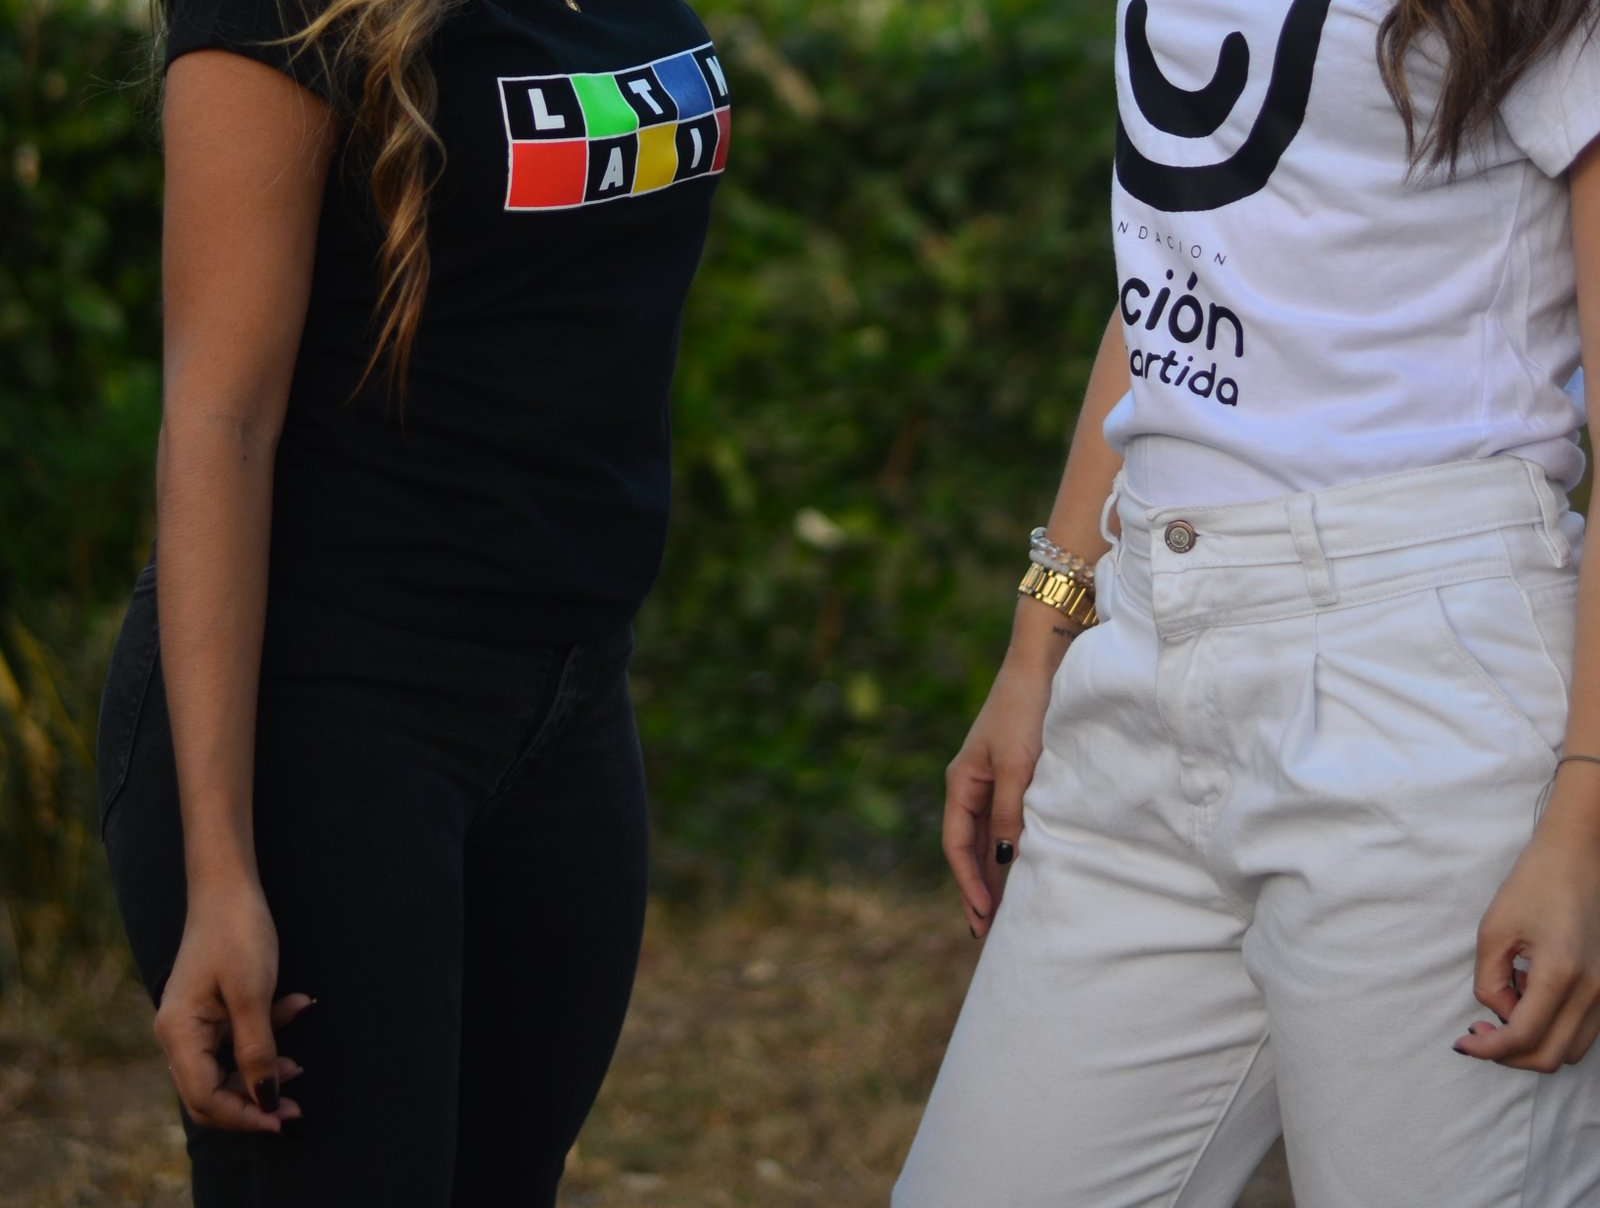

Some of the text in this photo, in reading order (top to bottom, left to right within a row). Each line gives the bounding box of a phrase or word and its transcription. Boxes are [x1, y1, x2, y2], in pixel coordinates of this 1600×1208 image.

[527, 88, 565, 131] L
[627, 78, 664, 115] T
[599, 146, 625, 192] A
[1119, 268, 1244, 359] ción
[1126, 344, 1239, 407] artida
